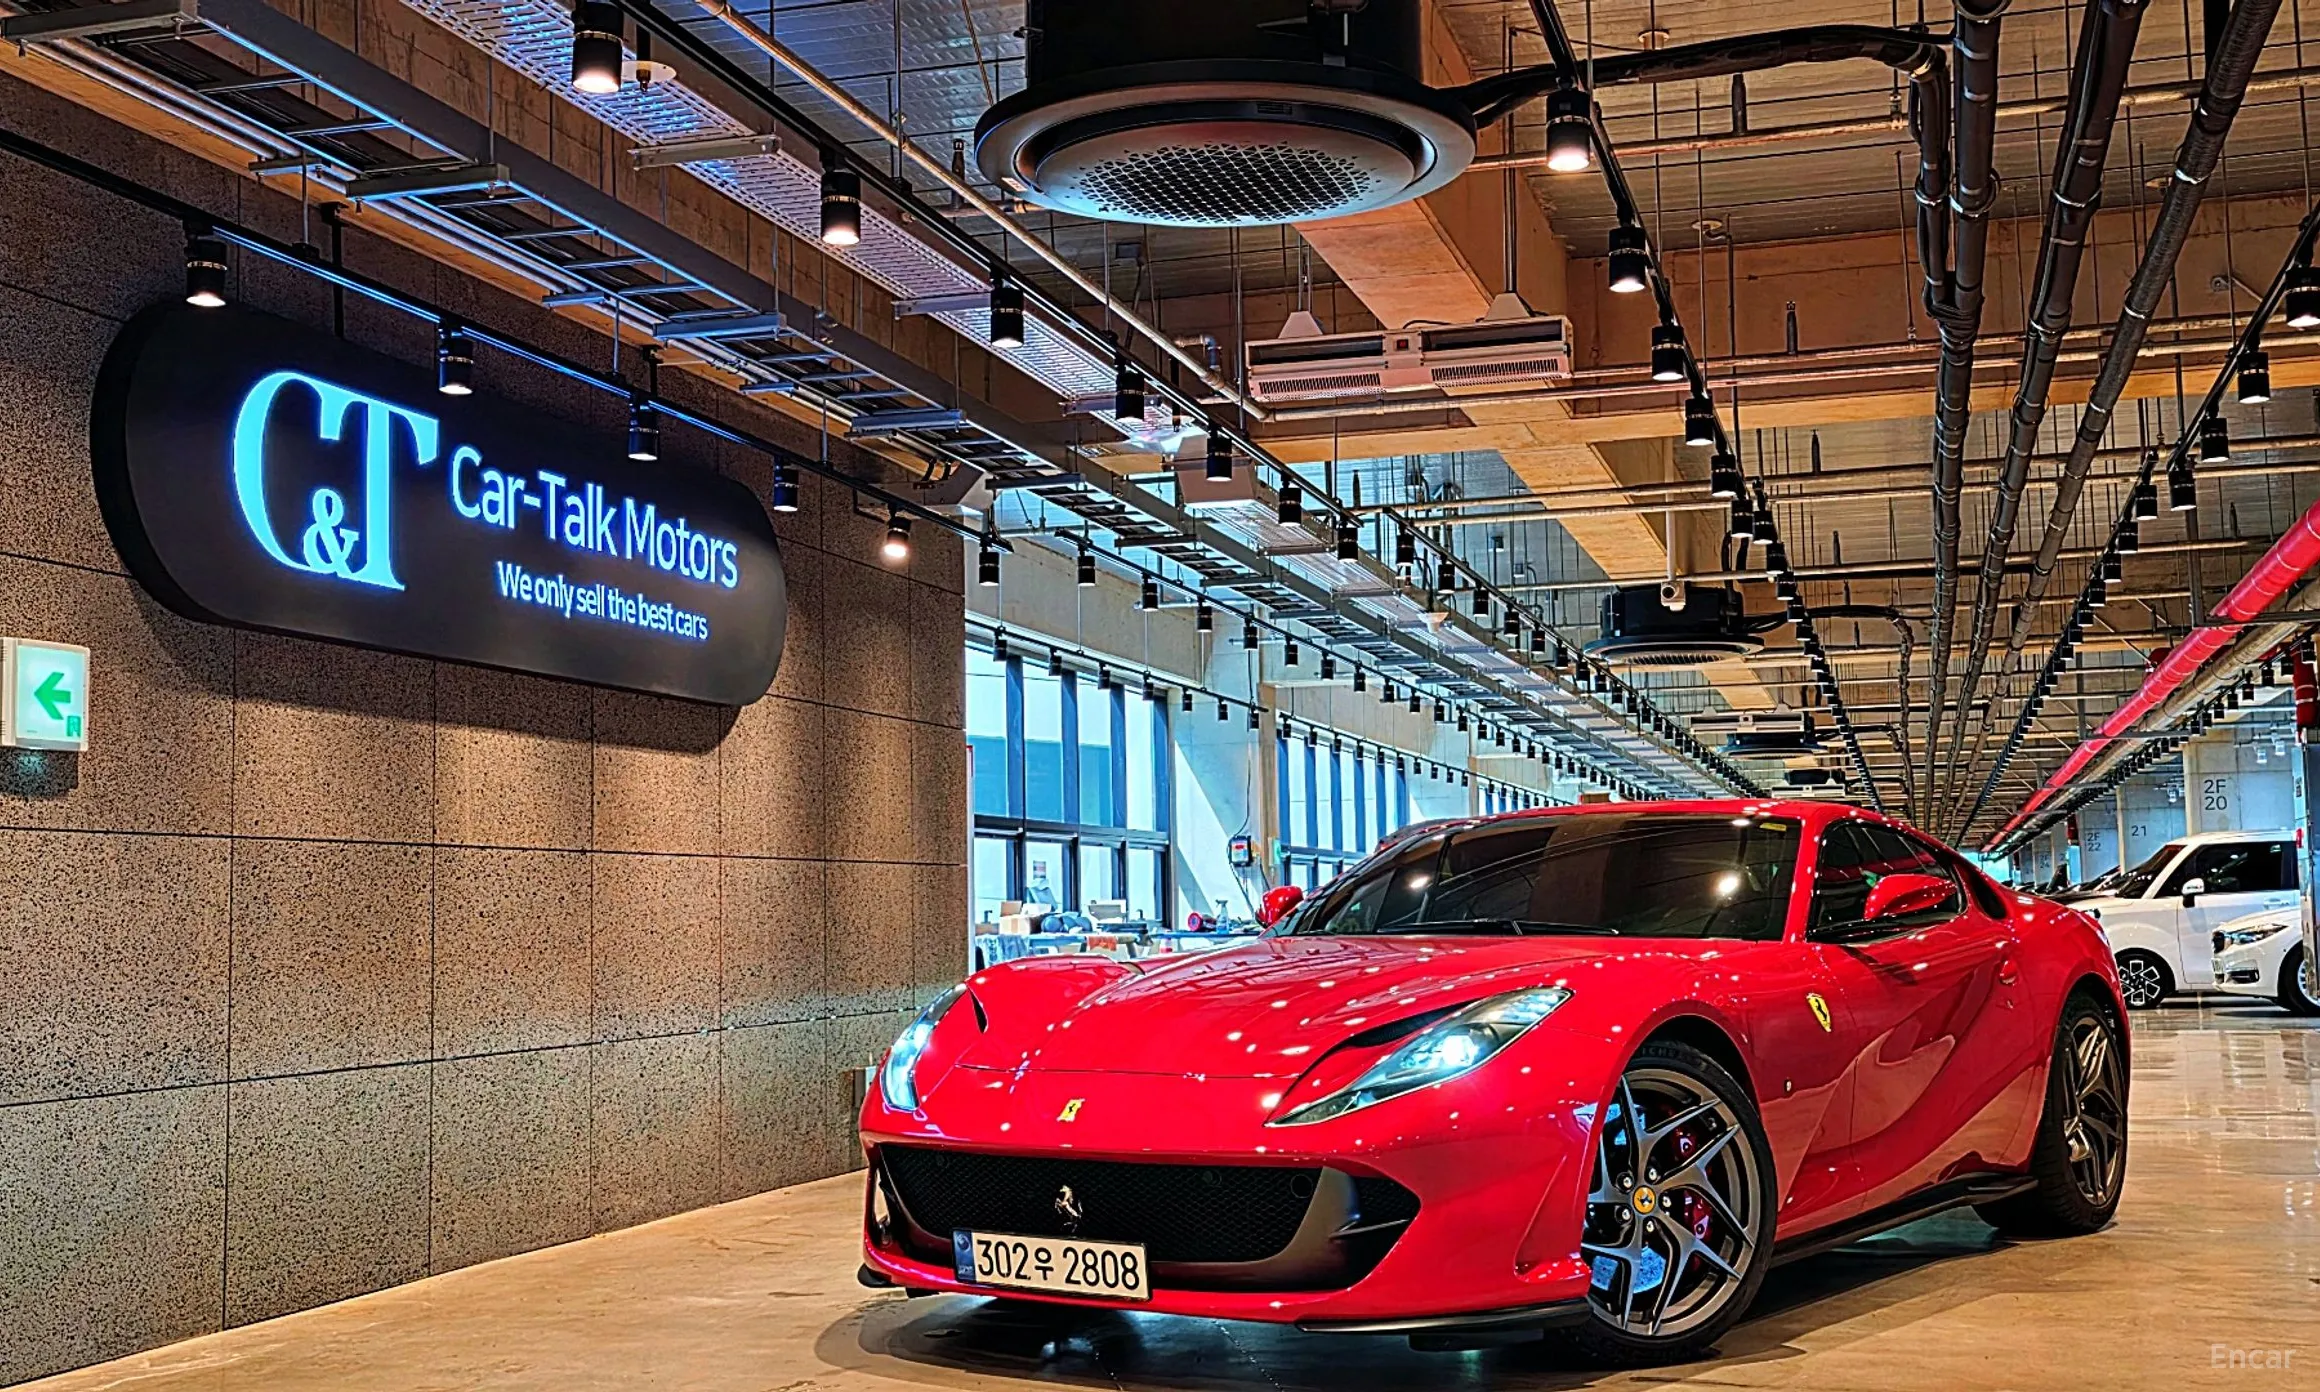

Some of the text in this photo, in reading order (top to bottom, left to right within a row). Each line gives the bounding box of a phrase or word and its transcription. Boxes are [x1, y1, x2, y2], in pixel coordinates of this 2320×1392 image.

[452, 446, 738, 588] Car-Talk Motors
[497, 561, 708, 639] We only sell the best cars
[2203, 779, 2226, 794] 2F
[2204, 795, 2228, 811] 20
[2087, 832, 2101, 841] 2F
[2131, 825, 2147, 837] 21
[2087, 842, 2101, 852] 22
[976, 1239, 1140, 1290] 302우 2808
